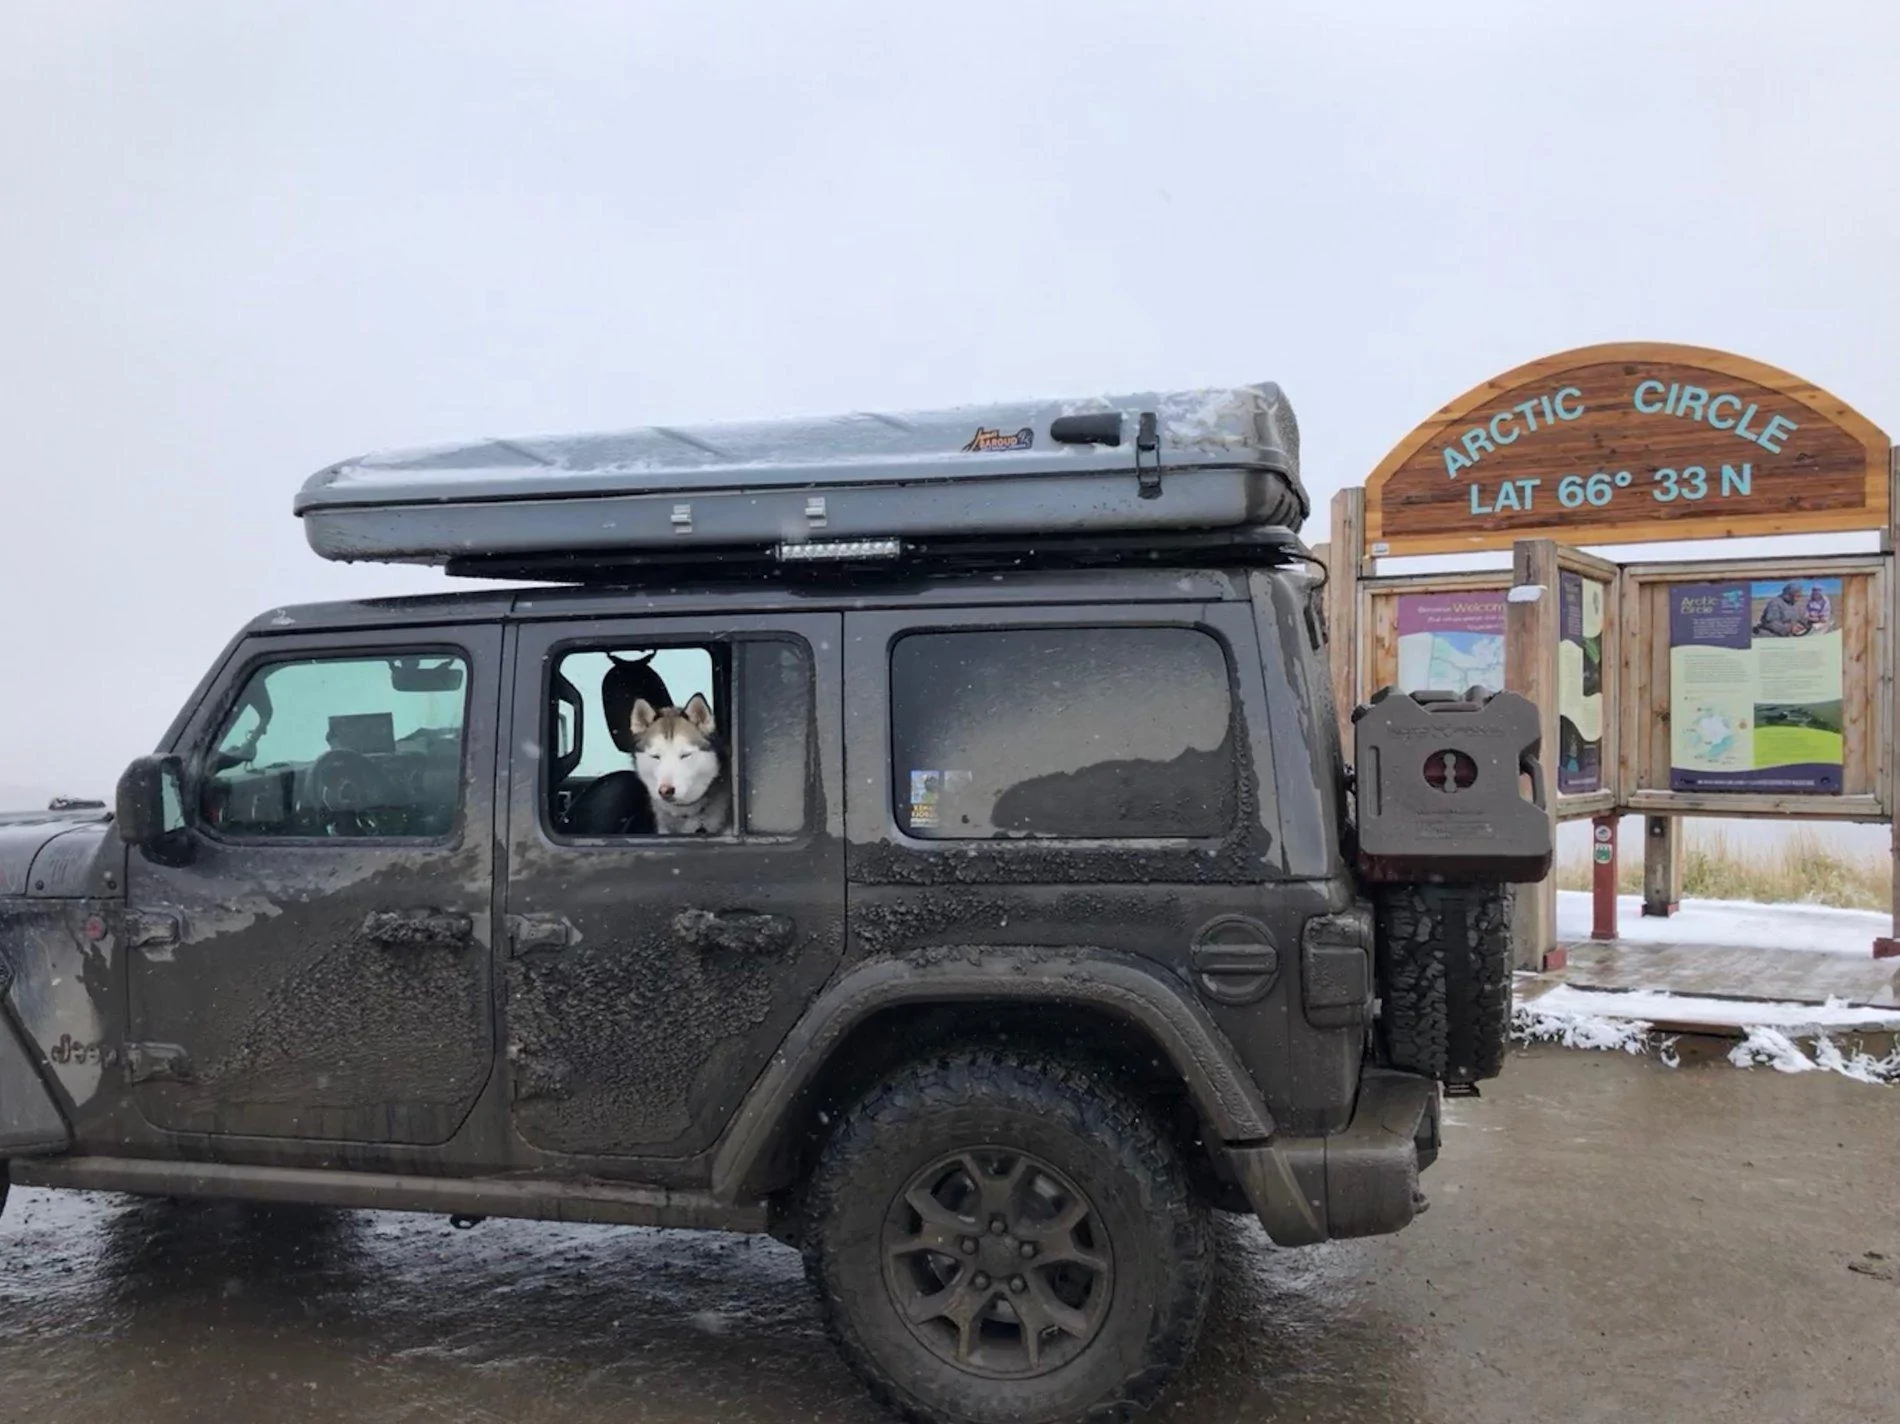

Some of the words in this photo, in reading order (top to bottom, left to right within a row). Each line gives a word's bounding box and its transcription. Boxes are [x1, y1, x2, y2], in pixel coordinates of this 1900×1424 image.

[1442, 387, 1585, 478] ARCTIC
[1633, 379, 1798, 454] CIRCLE
[1470, 478, 1541, 515] LAT
[1557, 470, 1633, 508] 66°
[1653, 464, 1708, 501] 33
[1720, 463, 1753, 497] N
[1452, 602, 1504, 613] Welcom
